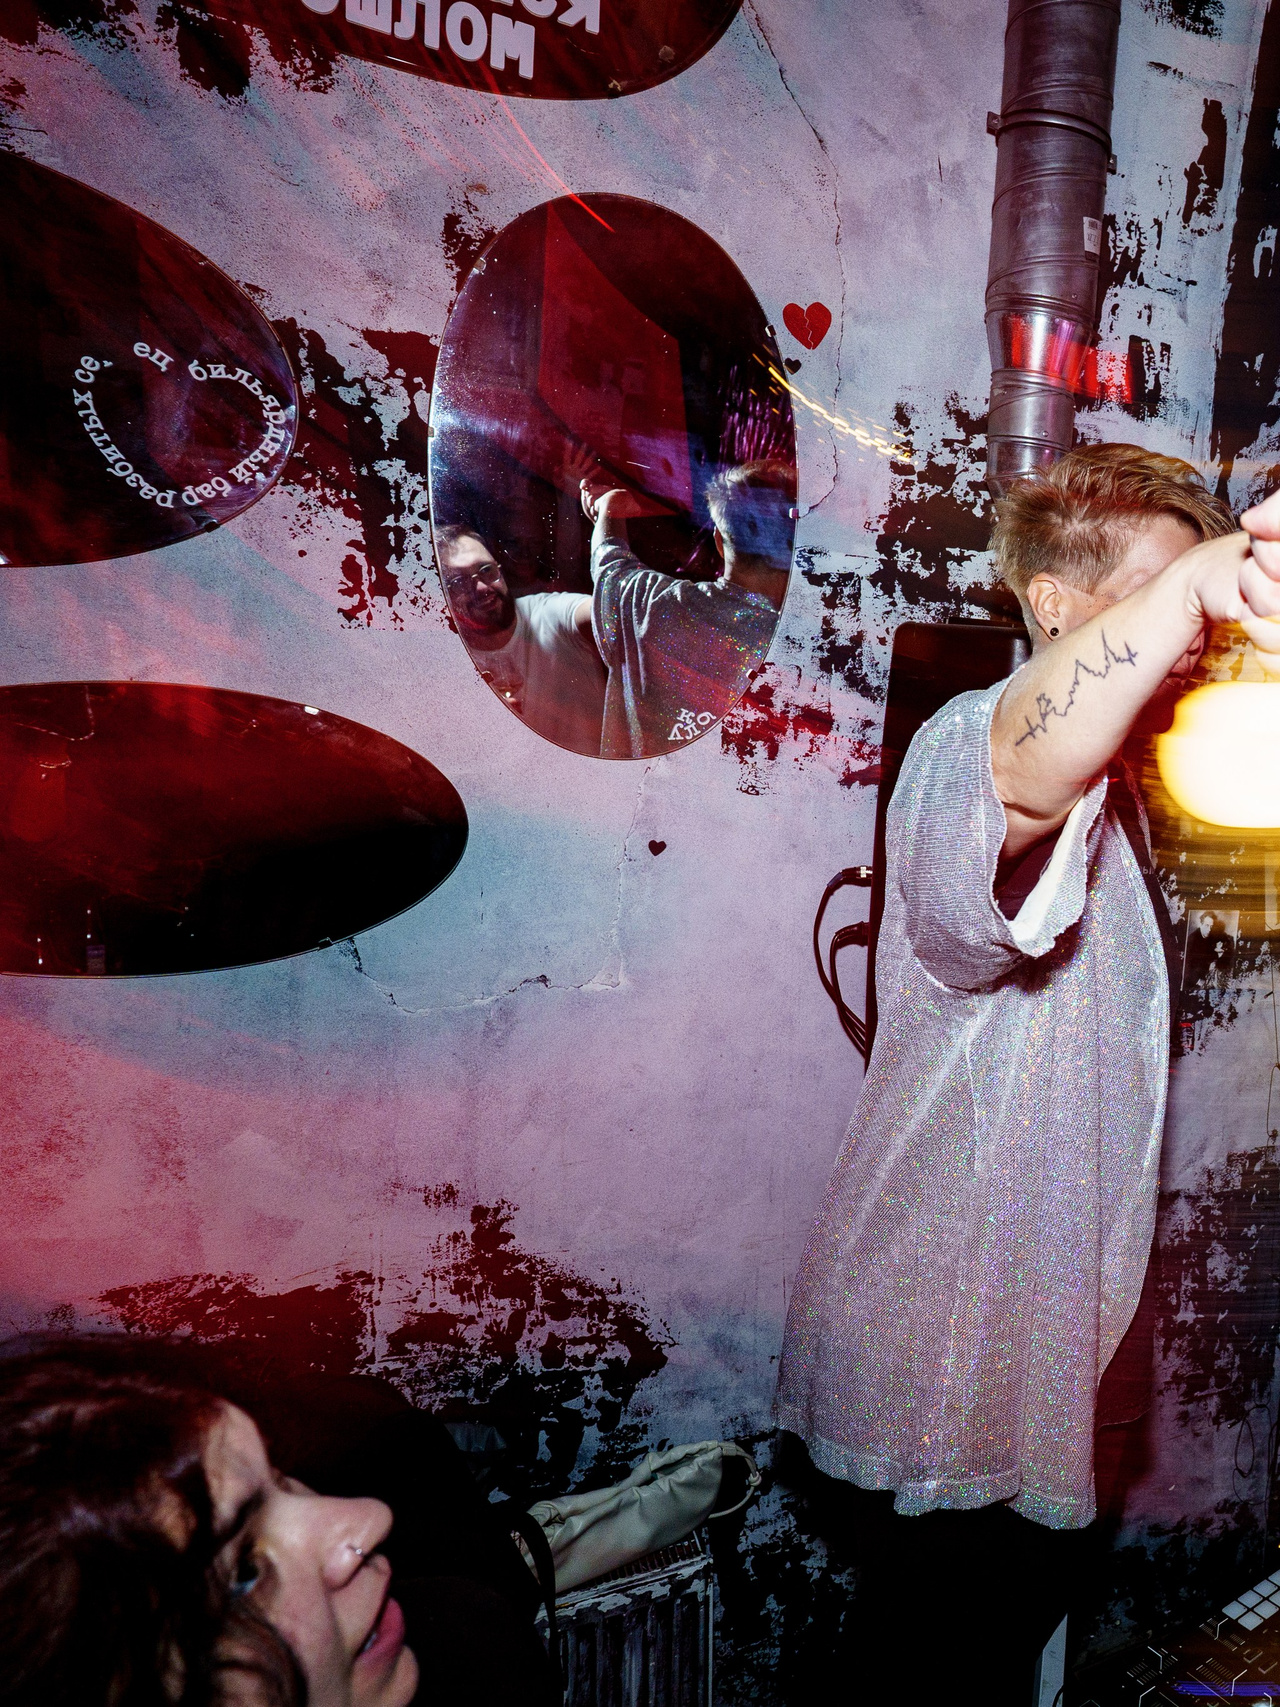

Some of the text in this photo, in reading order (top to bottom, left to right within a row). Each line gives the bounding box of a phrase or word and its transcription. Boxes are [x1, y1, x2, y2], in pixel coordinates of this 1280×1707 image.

[72, 388, 178, 509] разбитых
[188, 359, 287, 485] бильярдный
[181, 476, 232, 506] бар
